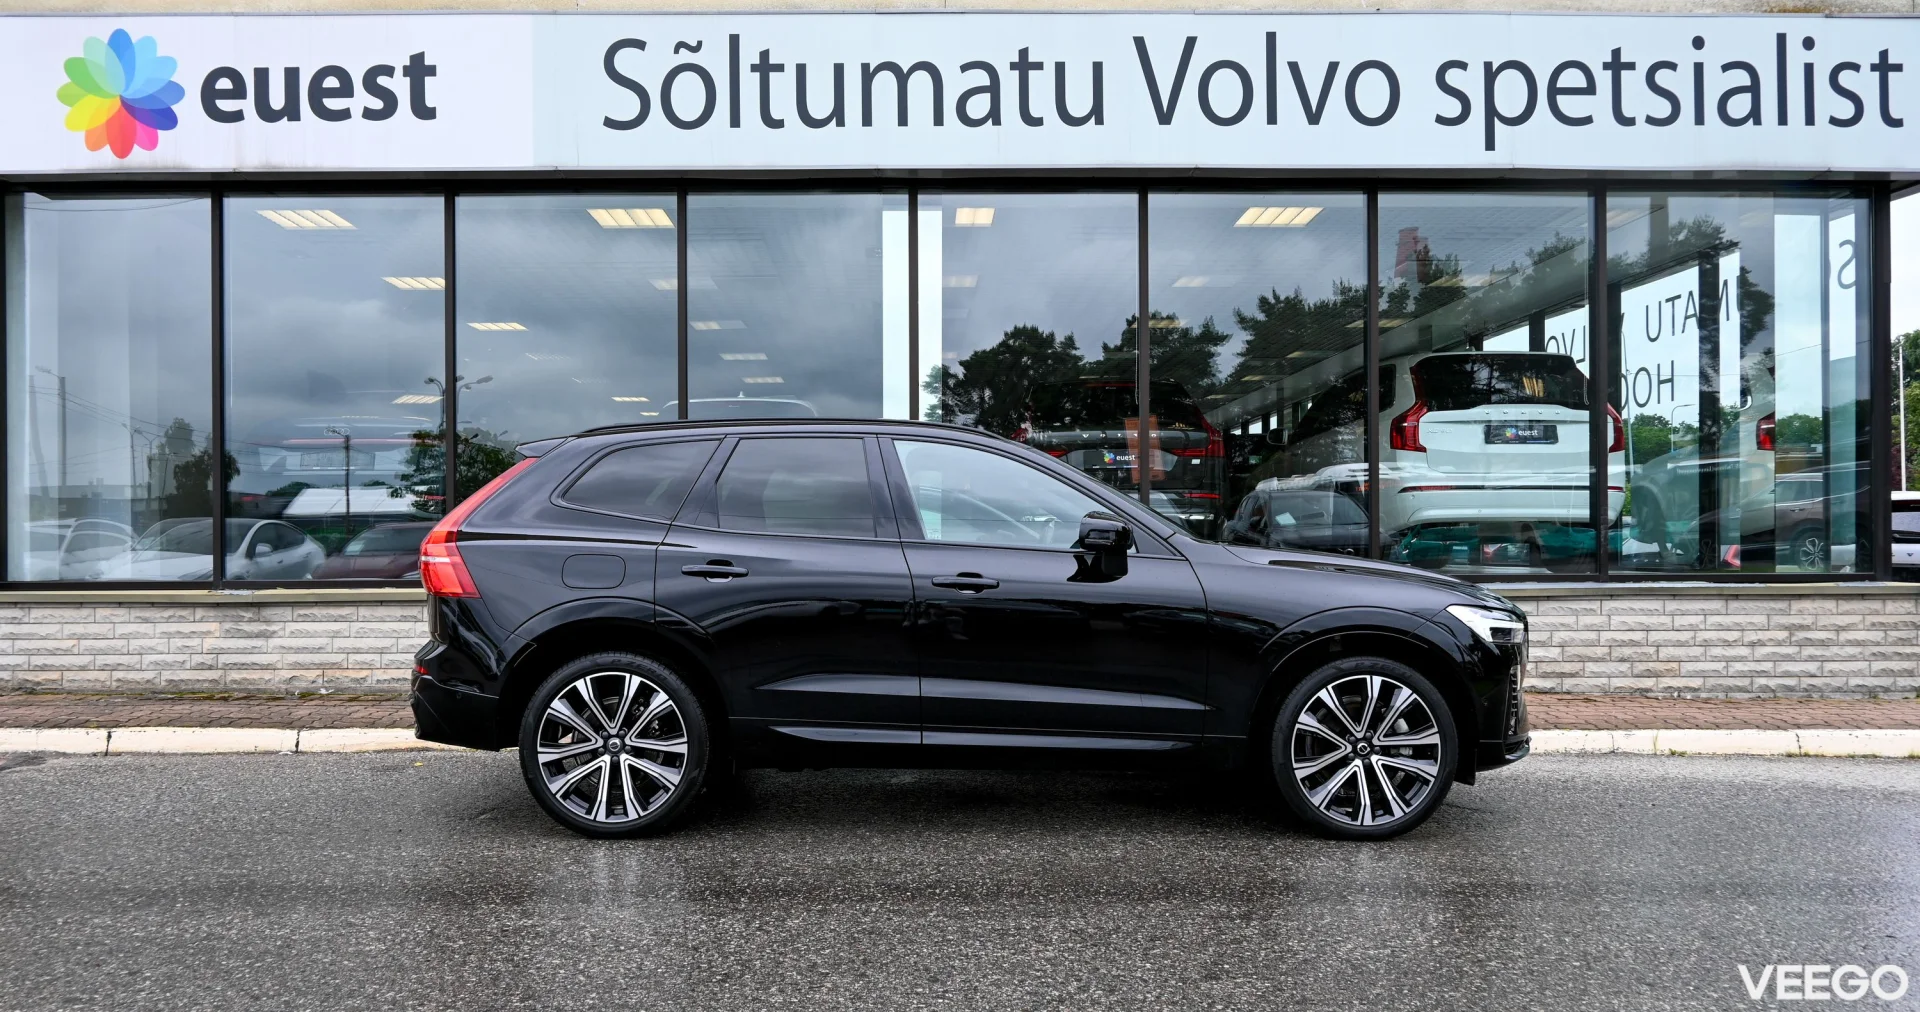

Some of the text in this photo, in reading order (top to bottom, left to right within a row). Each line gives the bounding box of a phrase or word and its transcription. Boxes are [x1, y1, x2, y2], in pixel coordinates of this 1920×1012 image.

[200, 51, 437, 124] euest
[602, 31, 1904, 152] Sõltumatu Volvo spetsialist
[1518, 429, 1539, 437] euest
